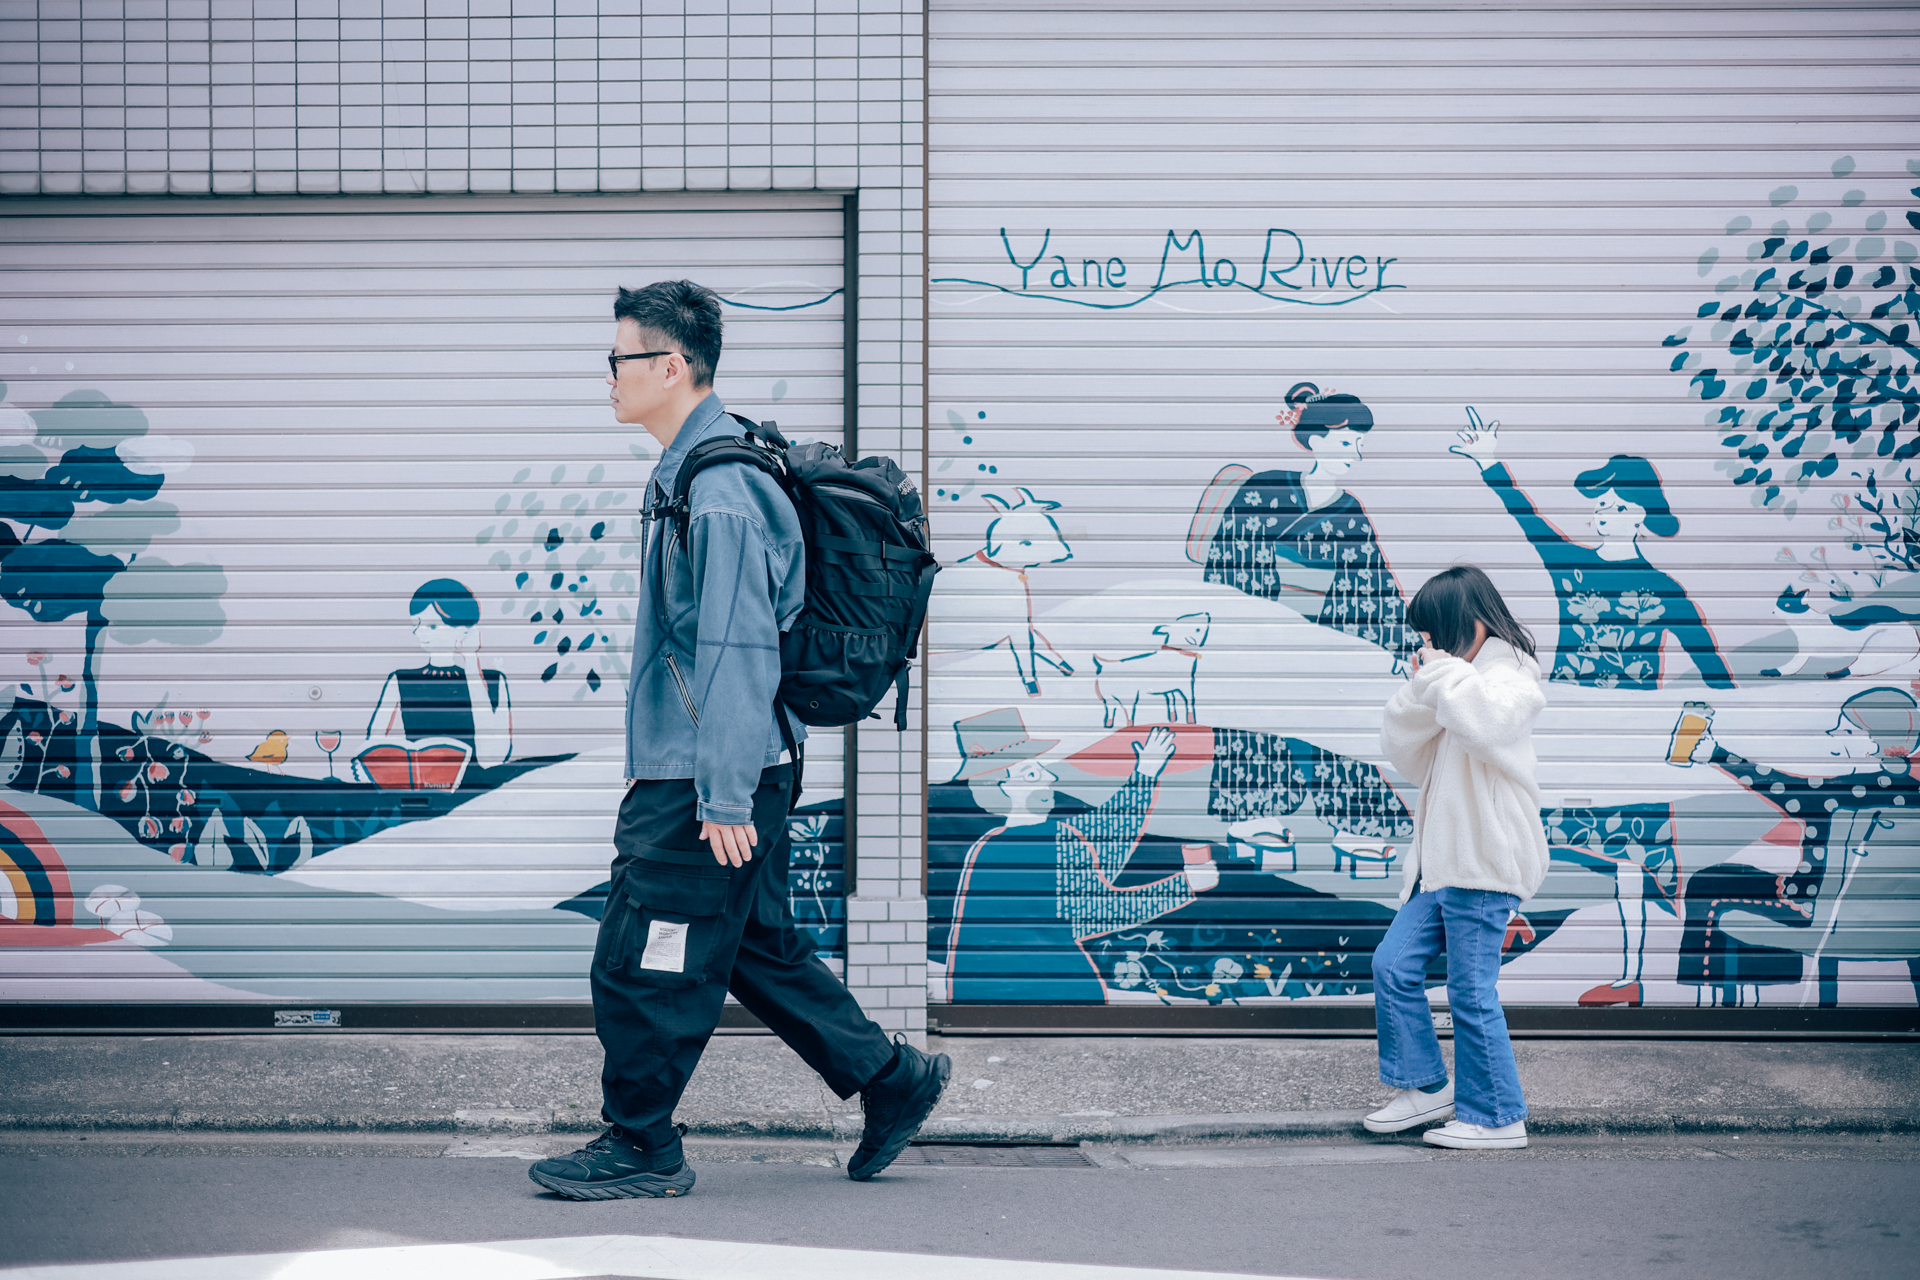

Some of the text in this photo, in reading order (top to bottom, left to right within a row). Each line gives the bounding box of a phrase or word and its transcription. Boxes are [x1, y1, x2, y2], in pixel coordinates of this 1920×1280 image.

[999, 226, 1407, 292] Yane Mo River
